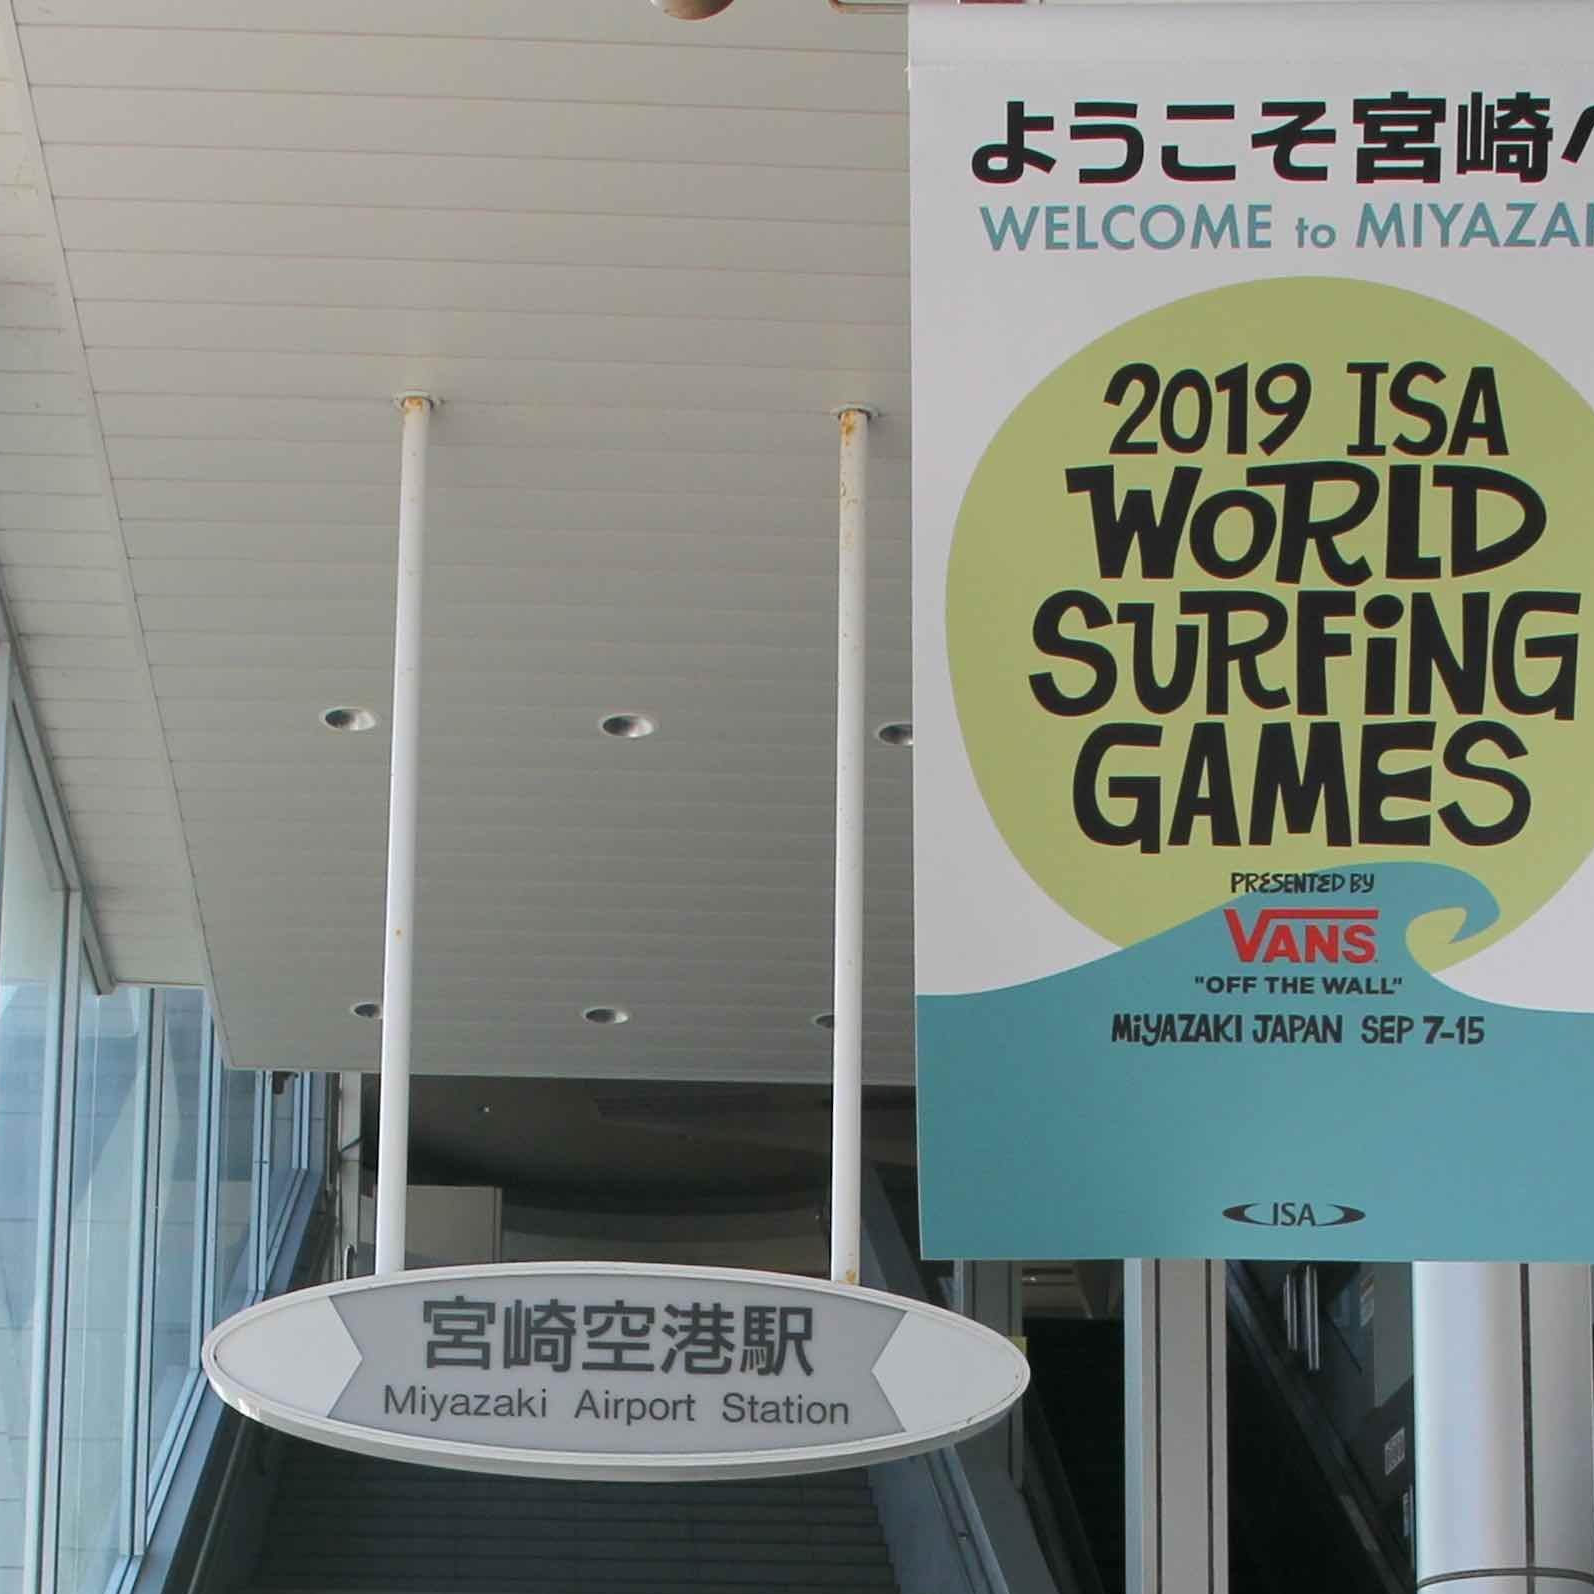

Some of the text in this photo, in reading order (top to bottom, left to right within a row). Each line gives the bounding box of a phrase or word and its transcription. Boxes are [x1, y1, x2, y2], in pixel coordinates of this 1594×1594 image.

[979, 203, 1273, 251] WELCOME
[1295, 217, 1337, 249] to
[1103, 361, 1509, 457] 2019 ISA
[1065, 460, 1547, 587] WORLD
[1072, 720, 1532, 854] GAMES
[1231, 872, 1375, 894] PRESENTED BY
[1224, 908, 1379, 964] VANS
[1266, 976, 1315, 995] THE
[1252, 1013, 1343, 1044] JAPAN
[1360, 1014, 1415, 1044] SEP
[1422, 1015, 1485, 1045] 7-15
[1272, 1202, 1317, 1227] ISA
[422, 1295, 815, 1377] 宮崎空港駅
[383, 1384, 850, 1427] Miyazaki Airport Station
